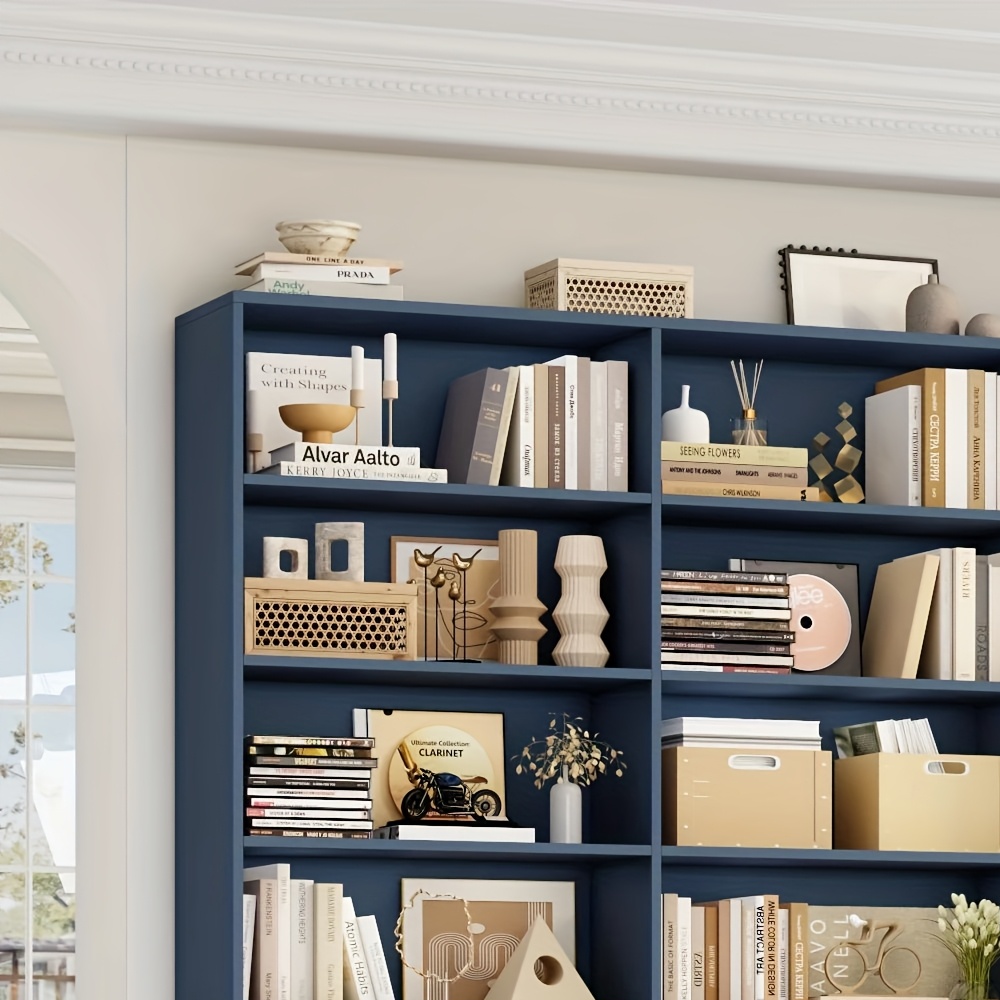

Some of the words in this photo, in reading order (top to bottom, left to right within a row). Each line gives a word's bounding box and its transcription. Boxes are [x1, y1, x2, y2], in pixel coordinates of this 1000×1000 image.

[337, 270, 375, 279] PRADA
[273, 280, 305, 291] Andy
[261, 363, 327, 379] Creating
[261, 378, 294, 388] with
[298, 379, 348, 394] Shapes
[930, 414, 940, 450] СЕСТРА
[302, 446, 350, 464] Alvar
[354, 449, 400, 467] Aalto
[679, 446, 706, 457] SEEING
[708, 446, 741, 459] FLOWERS
[972, 435, 980, 458] АННА
[286, 465, 326, 477] KERRY
[332, 467, 369, 478] JOYCE
[930, 452, 940, 482] КЕРРИ
[972, 460, 980, 501] КАРЕНИНА
[722, 488, 736, 496] CHRIS
[736, 488, 761, 497] WILKINSON
[976, 625, 988, 672] ROADS
[418, 748, 464, 758] CLARINET
[298, 882, 306, 918] WUTHERING
[327, 886, 336, 916] MADAME
[298, 918, 306, 944] HEIGHTS
[344, 921, 360, 958] Atomic
[354, 961, 370, 996] Habits
[668, 950, 673, 958] OF
[794, 942, 804, 972] СЕСТРА
[264, 972, 272, 988] Mary
